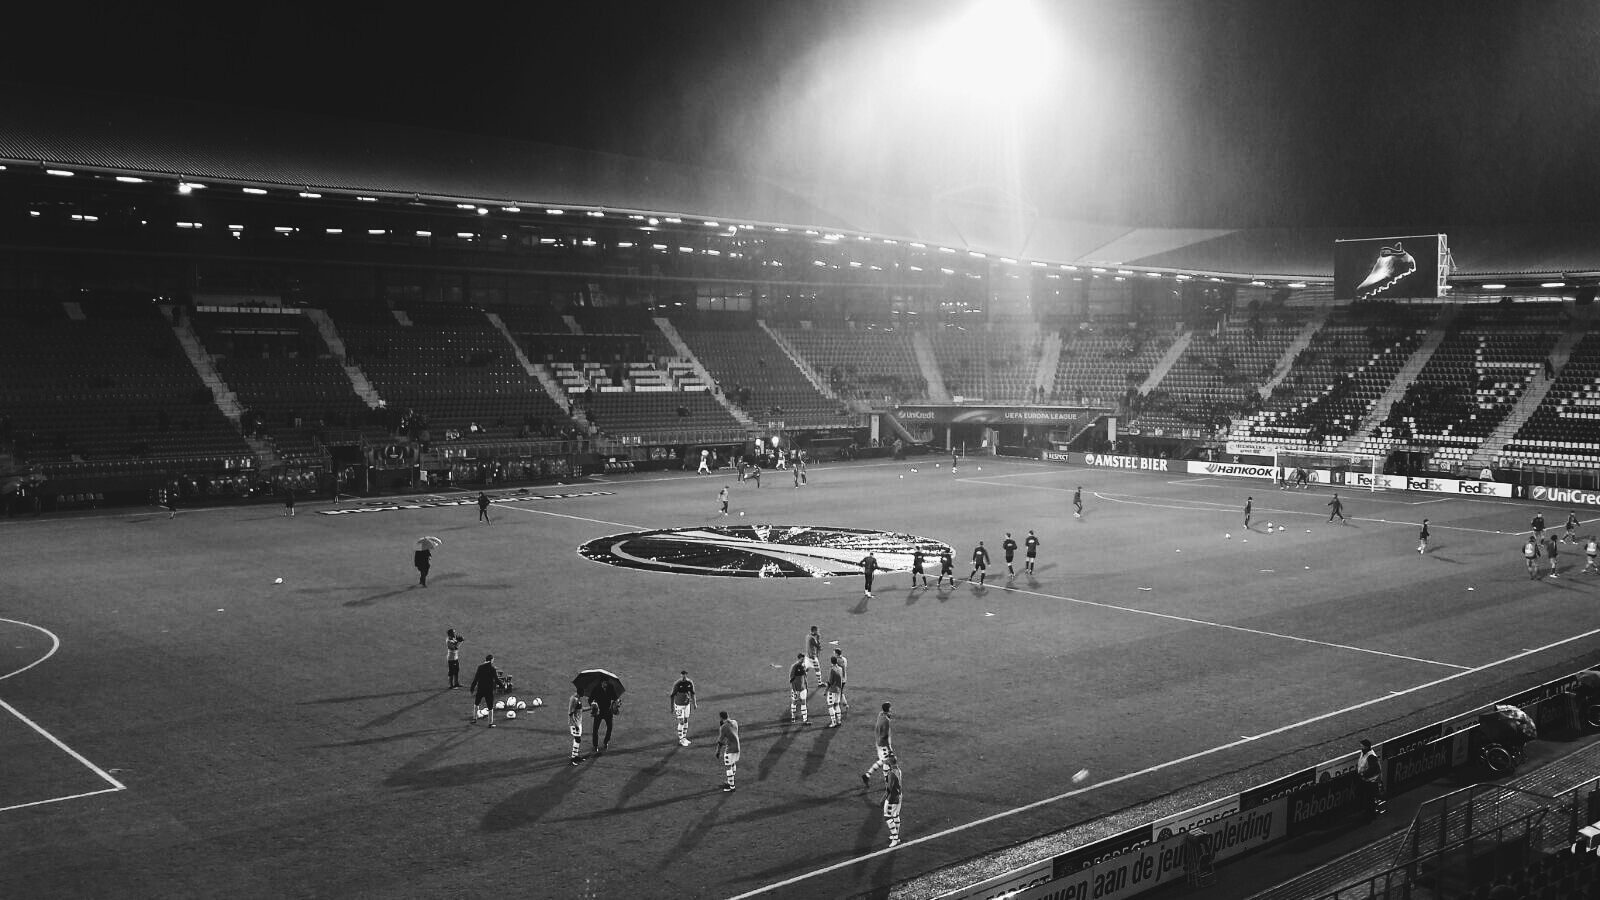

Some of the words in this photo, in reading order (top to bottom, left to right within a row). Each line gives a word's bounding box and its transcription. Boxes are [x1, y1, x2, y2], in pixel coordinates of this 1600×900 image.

[1004, 412, 1023, 420] UEFA
[1024, 412, 1049, 420] EUROPA
[1050, 413, 1077, 421] LEAGUE
[1095, 454, 1138, 469] AMSTEL
[1140, 458, 1168, 471] BIER
[1407, 478, 1442, 491] FedEx
[1458, 481, 1497, 495] FedEx
[1394, 745, 1447, 783] Rabobank
[1293, 780, 1357, 824] Rabobank
[1094, 864, 1127, 899] aan
[1132, 851, 1154, 884] de
